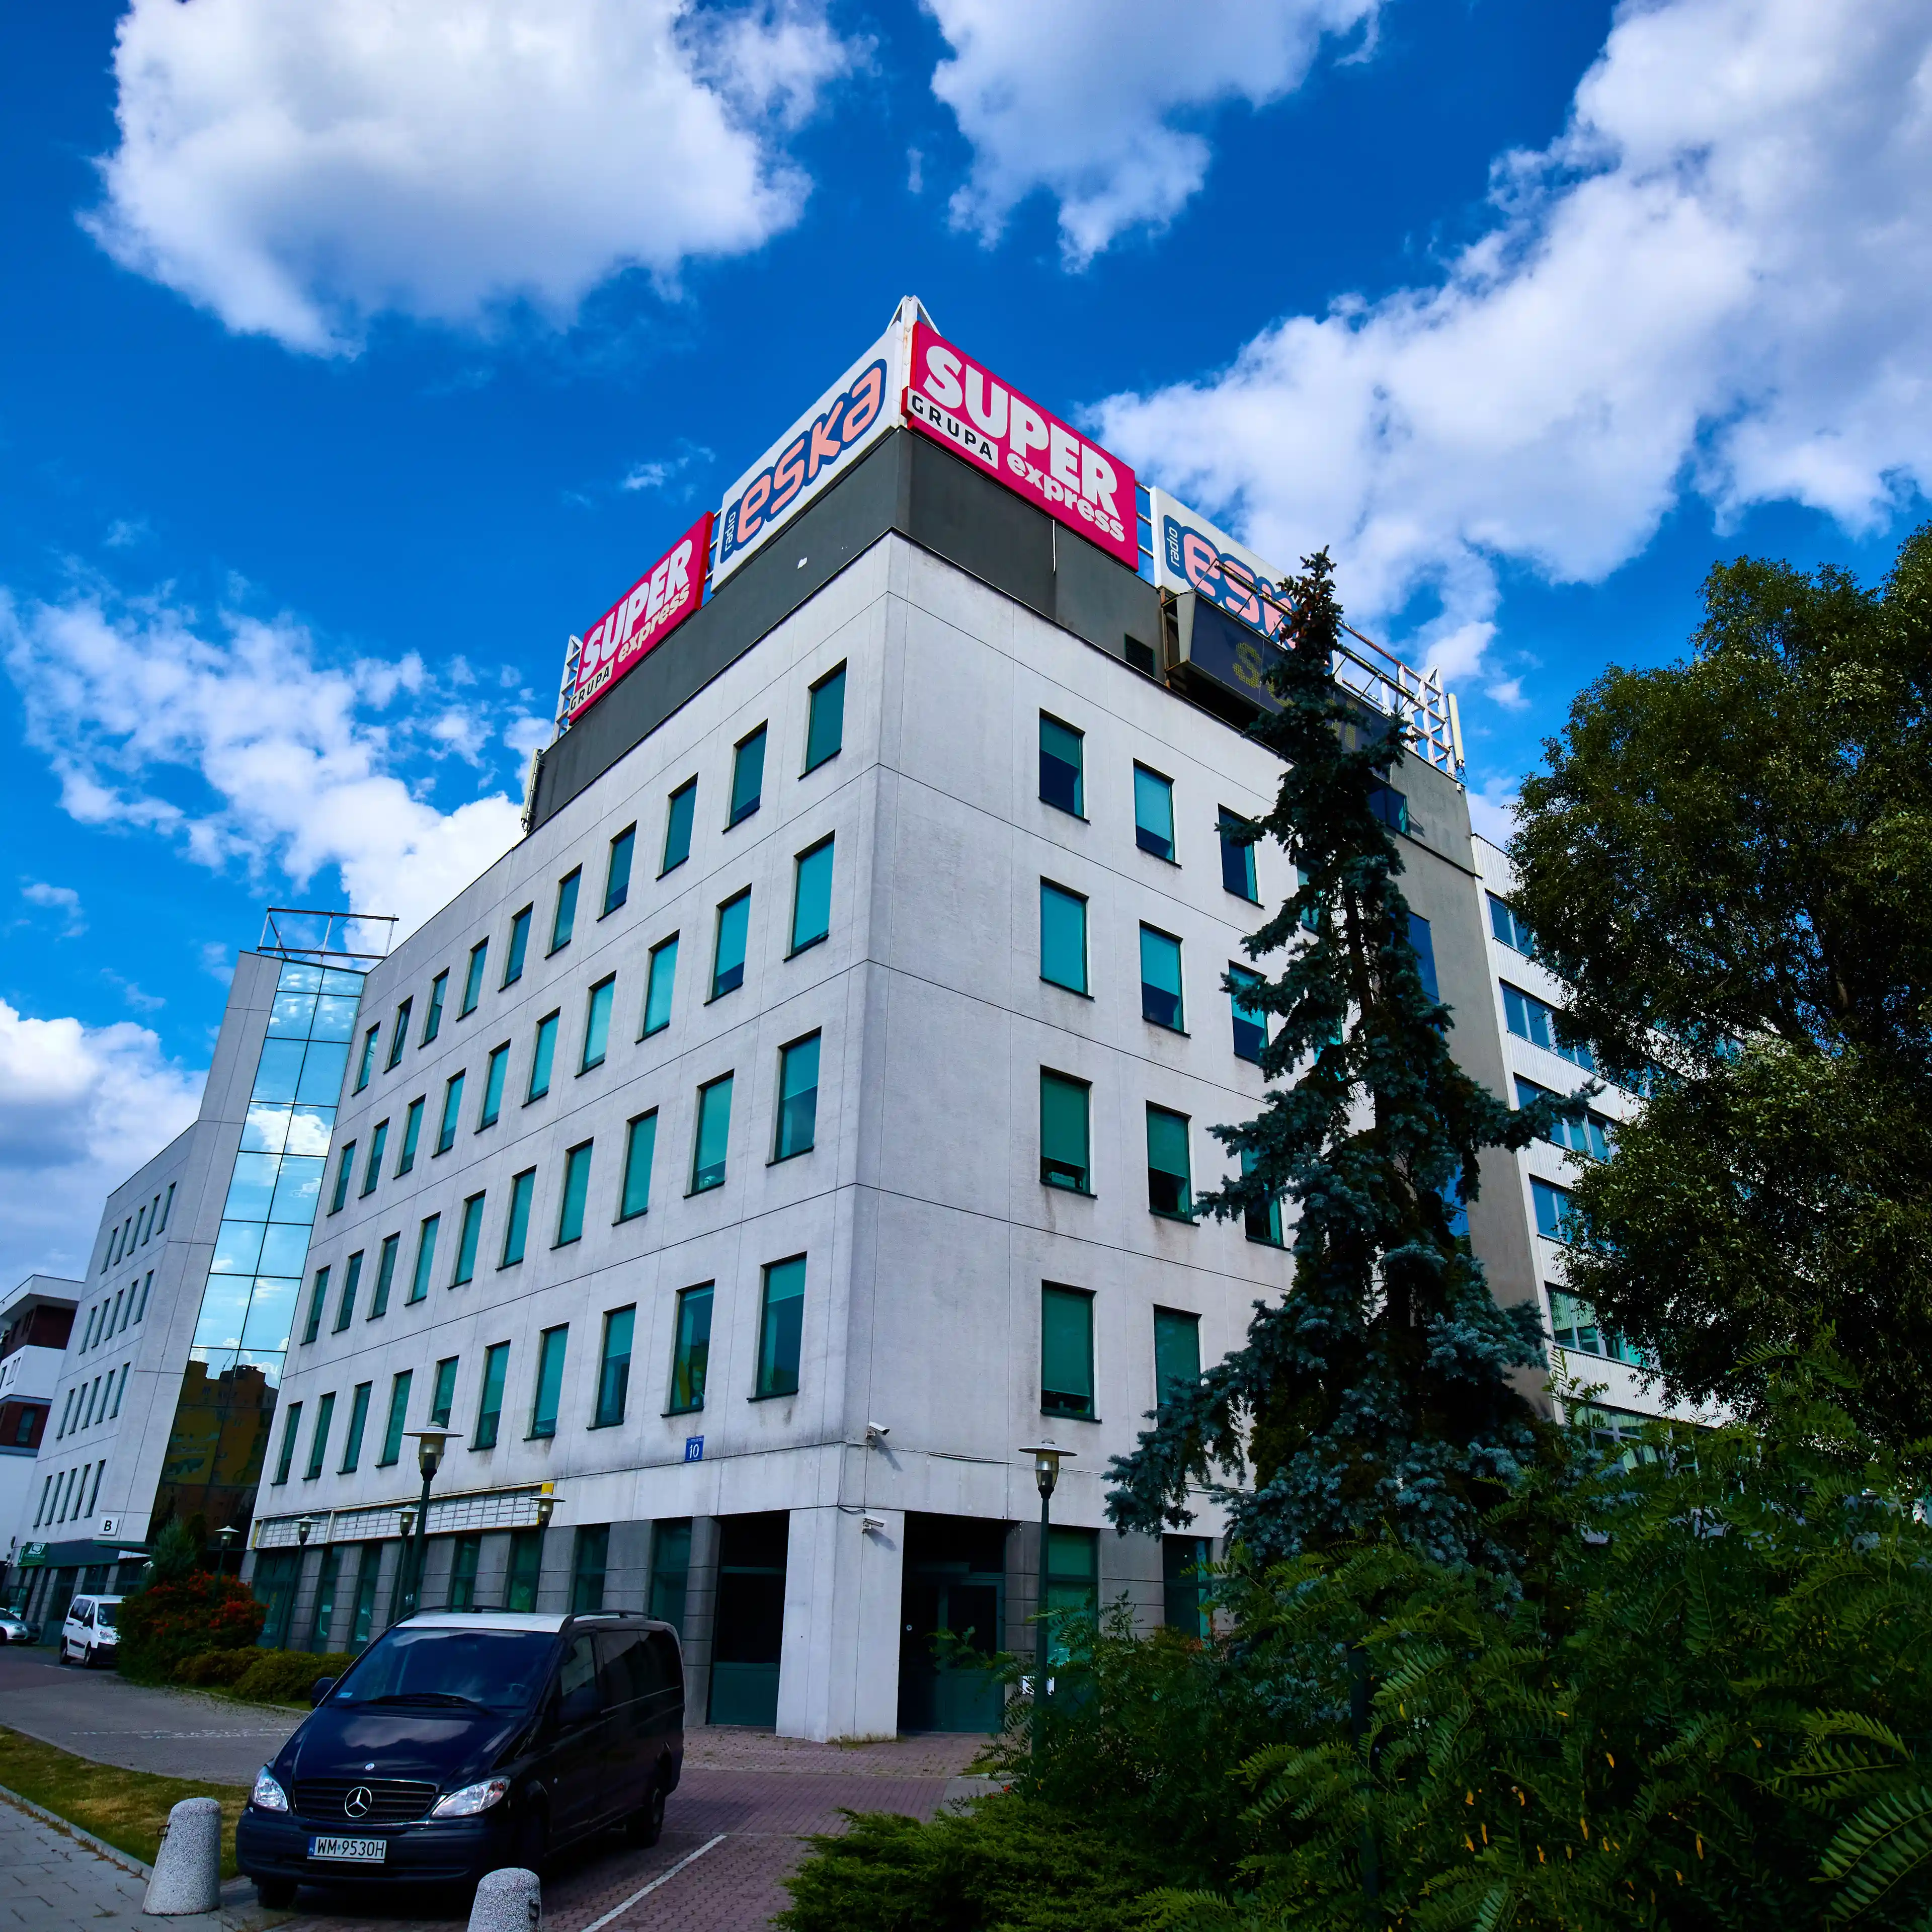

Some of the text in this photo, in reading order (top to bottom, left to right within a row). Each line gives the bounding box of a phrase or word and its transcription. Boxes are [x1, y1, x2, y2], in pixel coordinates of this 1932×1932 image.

[737, 367, 881, 543] eska
[912, 395, 993, 461] GRUPA
[923, 346, 1120, 520] SUPER
[1007, 453, 1125, 542] express
[725, 511, 736, 552] radio
[1166, 526, 1179, 567] radio
[579, 539, 693, 683] SUPER
[618, 584, 690, 663] express
[1183, 533, 1327, 665] esk
[570, 666, 610, 711] GRUPA
[689, 1443, 699, 1459] 10
[103, 1520, 112, 1532] B
[317, 1838, 385, 1857] WM 9530H
